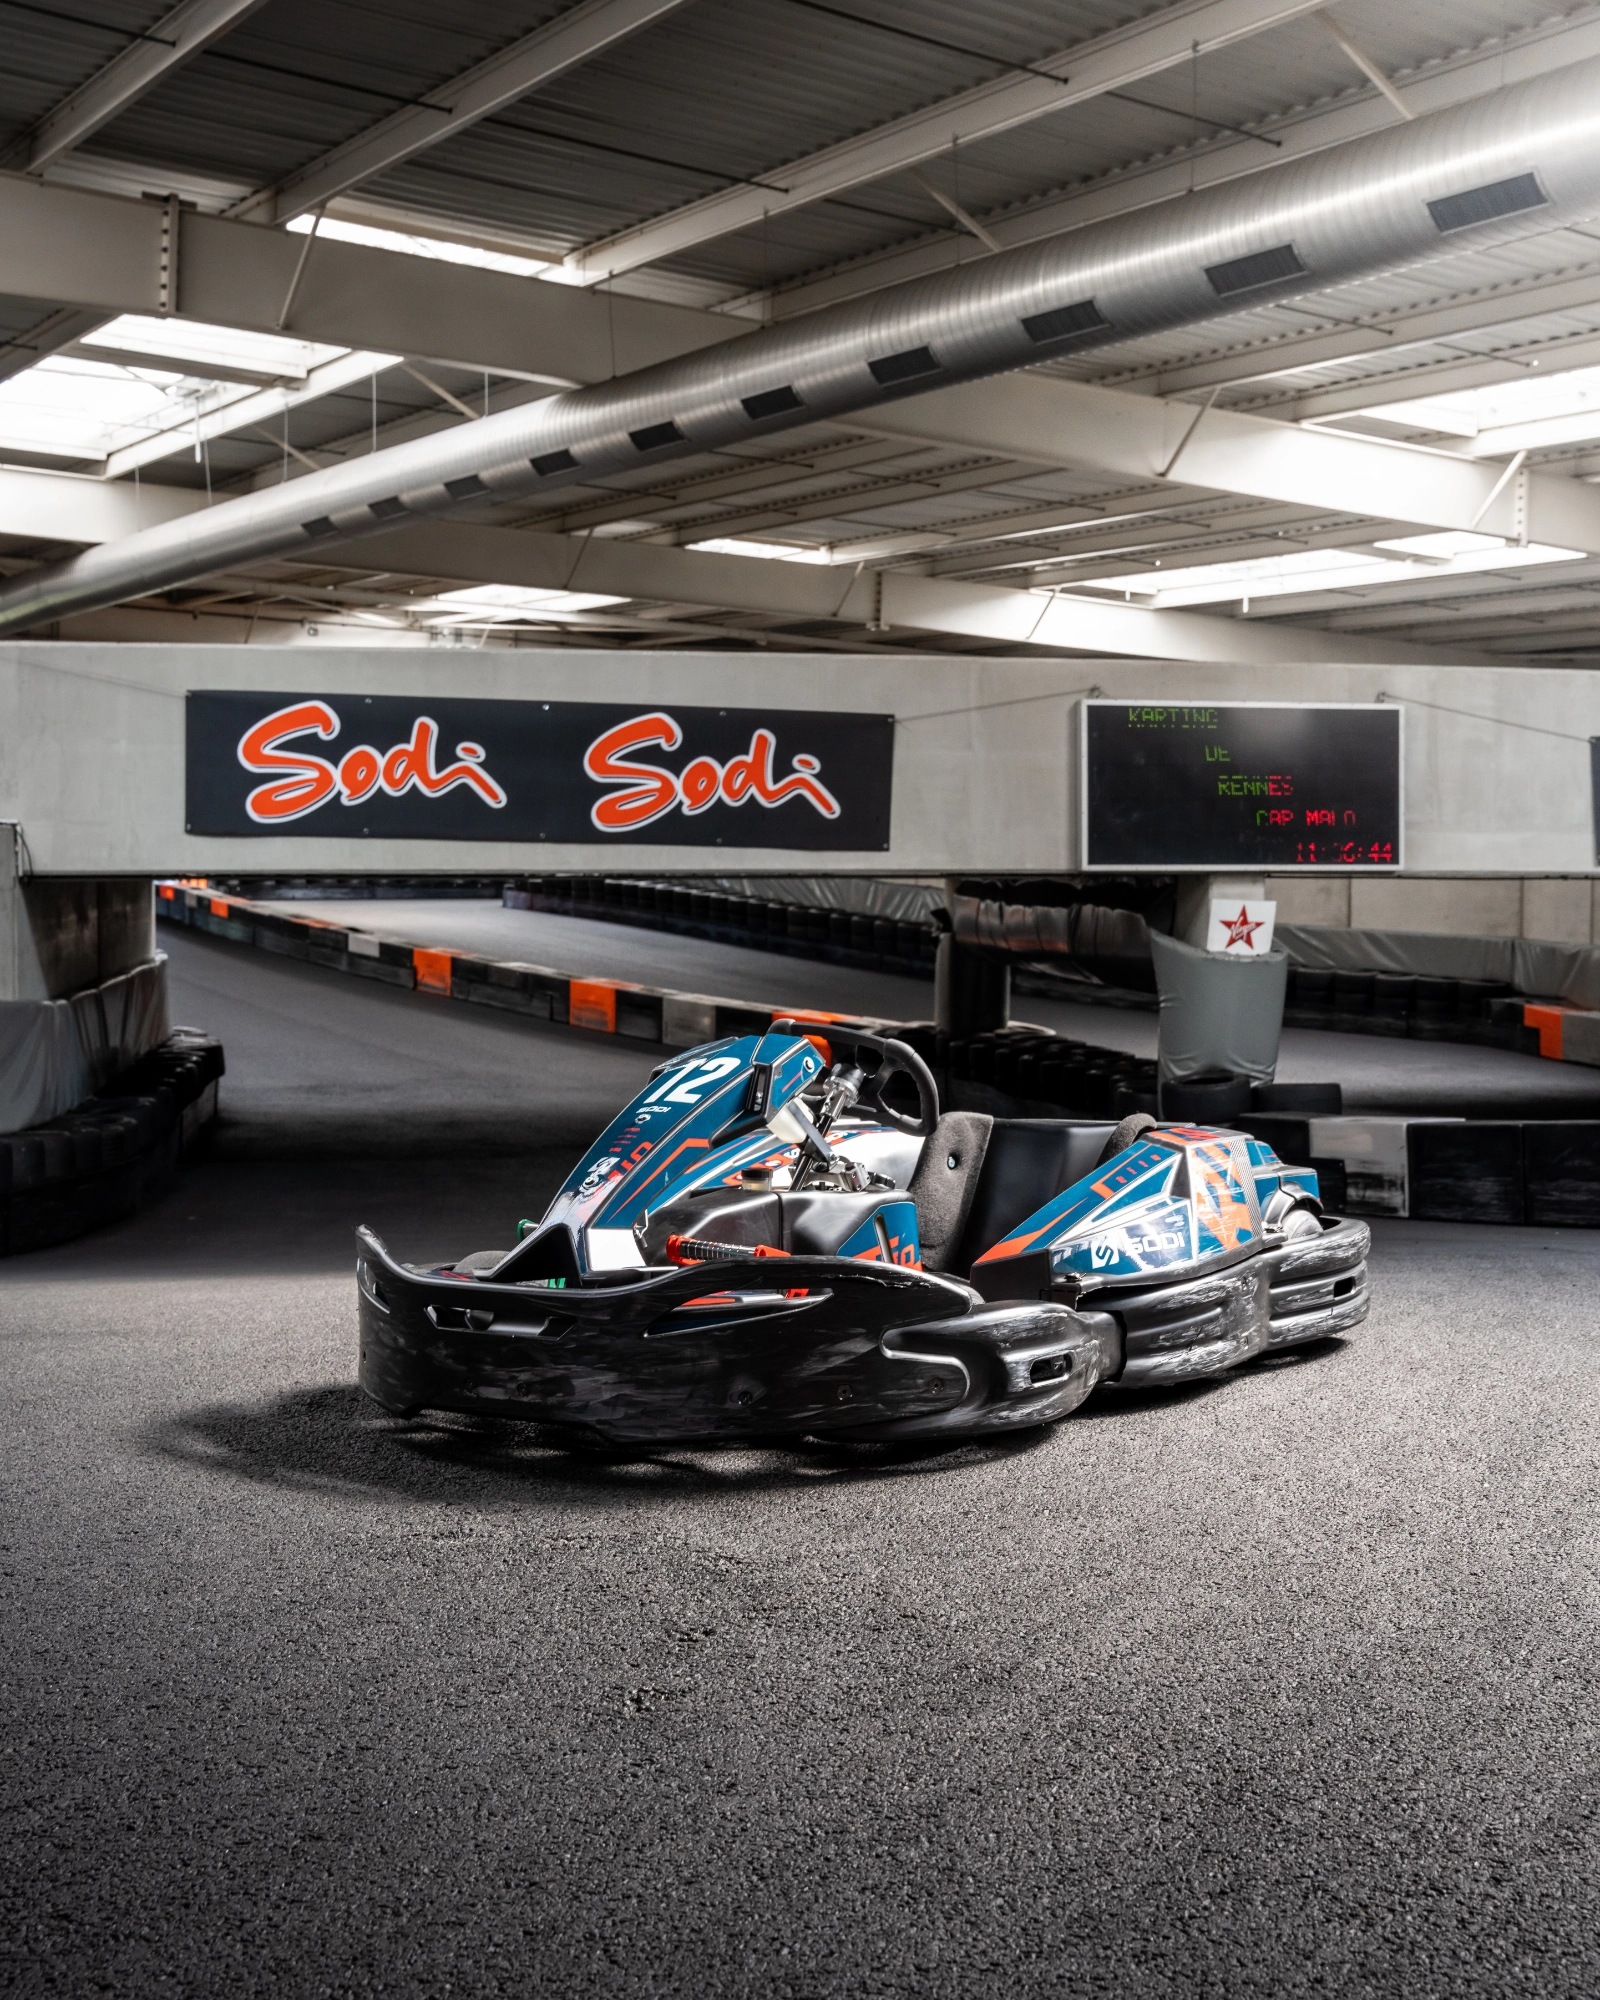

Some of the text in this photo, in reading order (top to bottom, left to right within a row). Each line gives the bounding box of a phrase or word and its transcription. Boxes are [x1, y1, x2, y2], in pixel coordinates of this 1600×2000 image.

[236, 700, 841, 832] Sodi Sodi
[643, 1057, 741, 1104] 12
